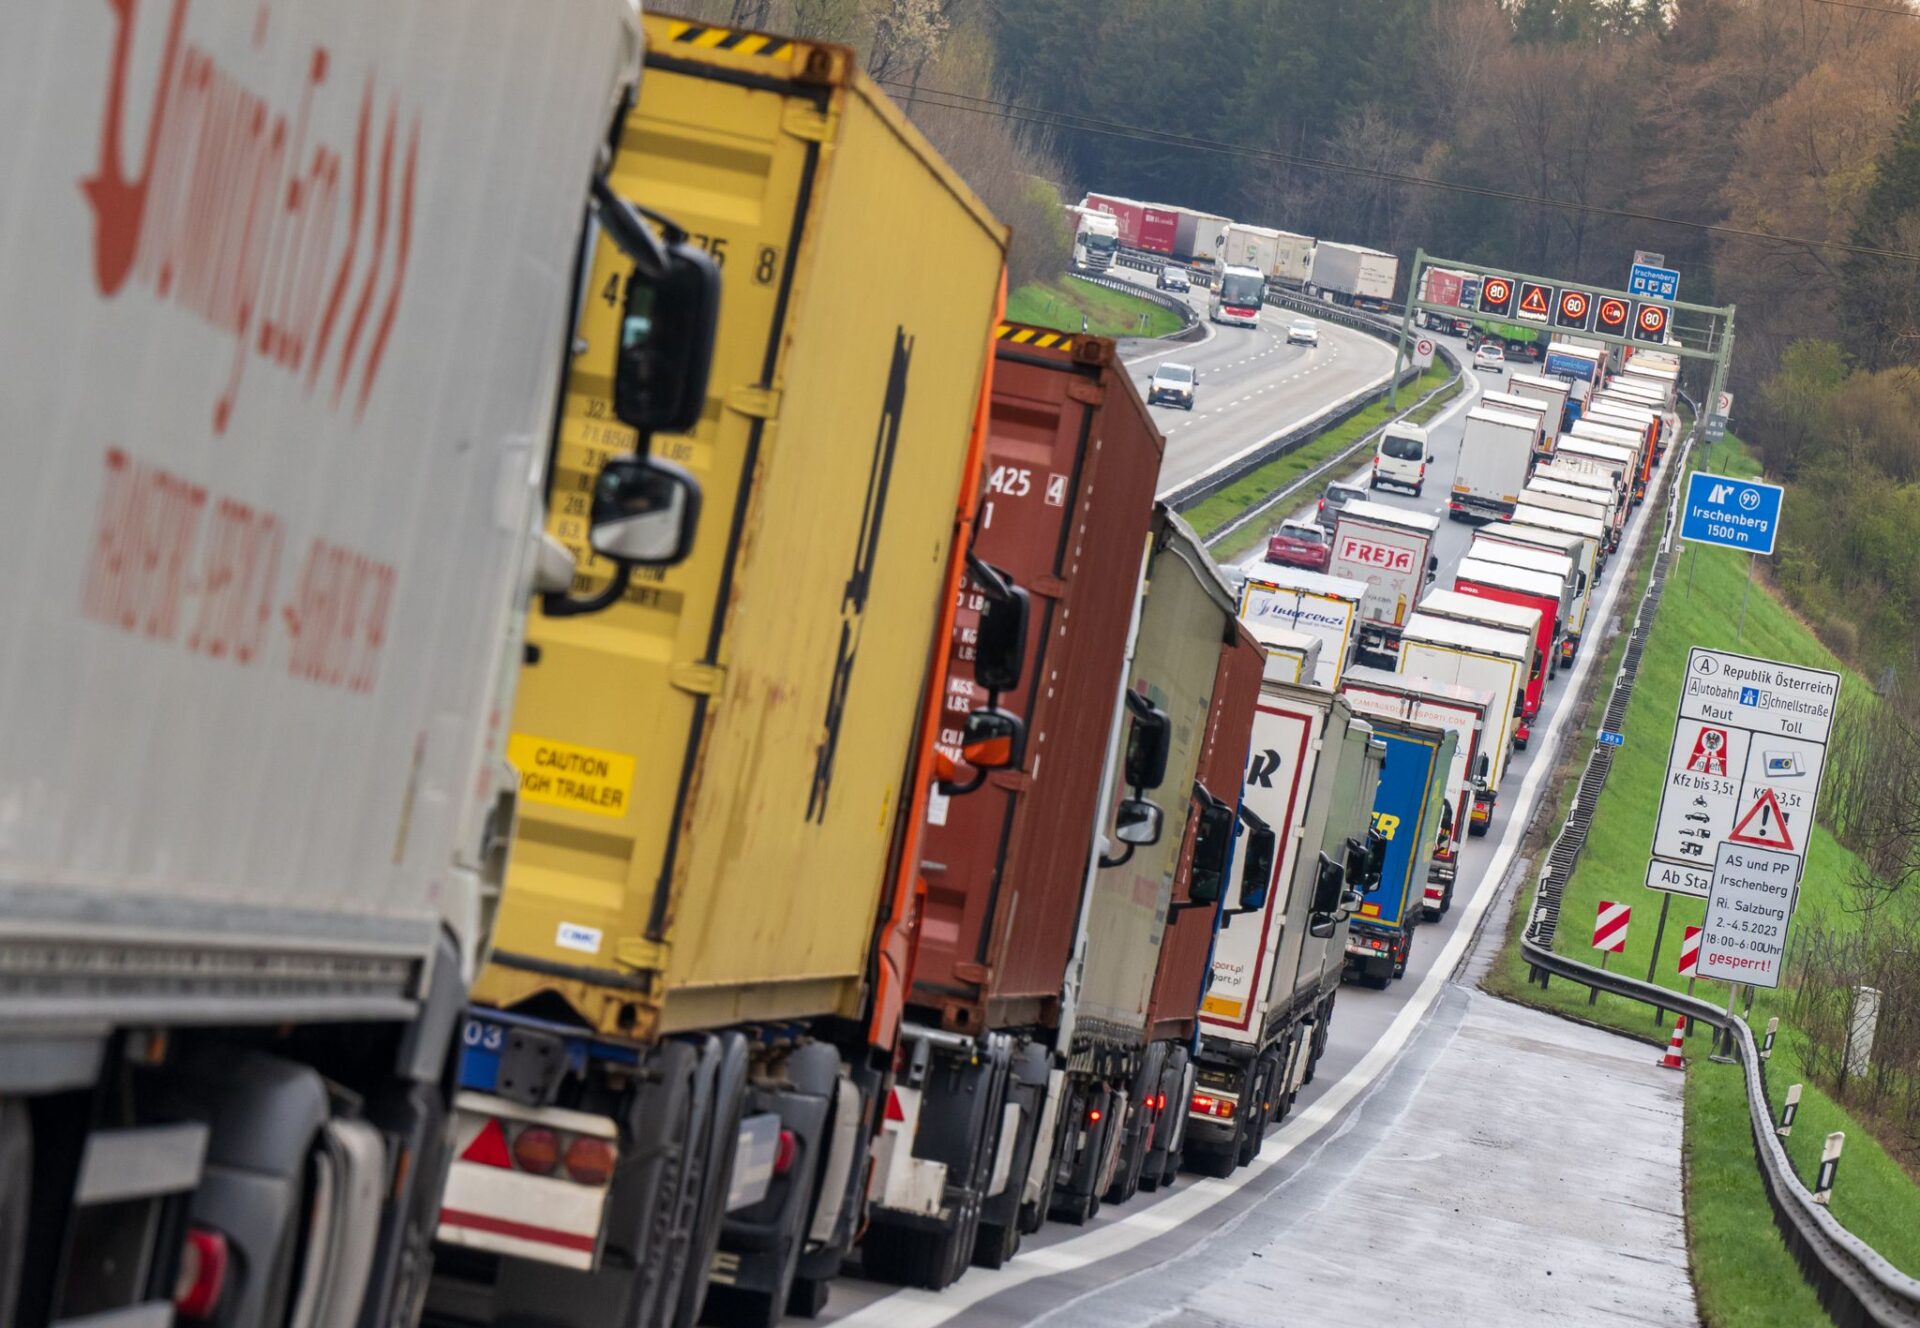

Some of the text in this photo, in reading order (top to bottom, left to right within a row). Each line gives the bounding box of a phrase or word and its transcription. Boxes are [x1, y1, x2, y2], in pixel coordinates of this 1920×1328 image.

[756, 247, 776, 285] 8
[1635, 268, 1676, 283] Irschenberg
[1490, 286, 1504, 299] 80
[1567, 299, 1581, 312] 80
[1645, 313, 1660, 326] 80
[1050, 477, 1065, 504] 4
[1742, 493, 1757, 506] 99
[1693, 506, 1768, 532] Irschenberg
[1707, 524, 1748, 542] 1500 m
[1345, 542, 1410, 568] FREJA
[1700, 658, 1833, 696] A Republik Österreich
[1690, 680, 1829, 717] Autobahn Schnellstraße
[1701, 704, 1734, 721] Maut
[1781, 719, 1802, 734] Toll
[535, 747, 609, 778] CAUTION
[1247, 749, 1281, 788] R
[520, 771, 623, 809] IGH TRAILER
[1673, 772, 1734, 796] Kfz bis 3,5t
[1726, 854, 1790, 874] AS und PP
[1661, 869, 1711, 890] Ab Sta
[1720, 874, 1788, 898] Irschenberg
[1716, 897, 1784, 921] Ri. Salzburg
[1716, 917, 1777, 937] 2.-4.5.2023
[1709, 953, 1772, 972] gesperrt!
[463, 1021, 502, 1049] 03
